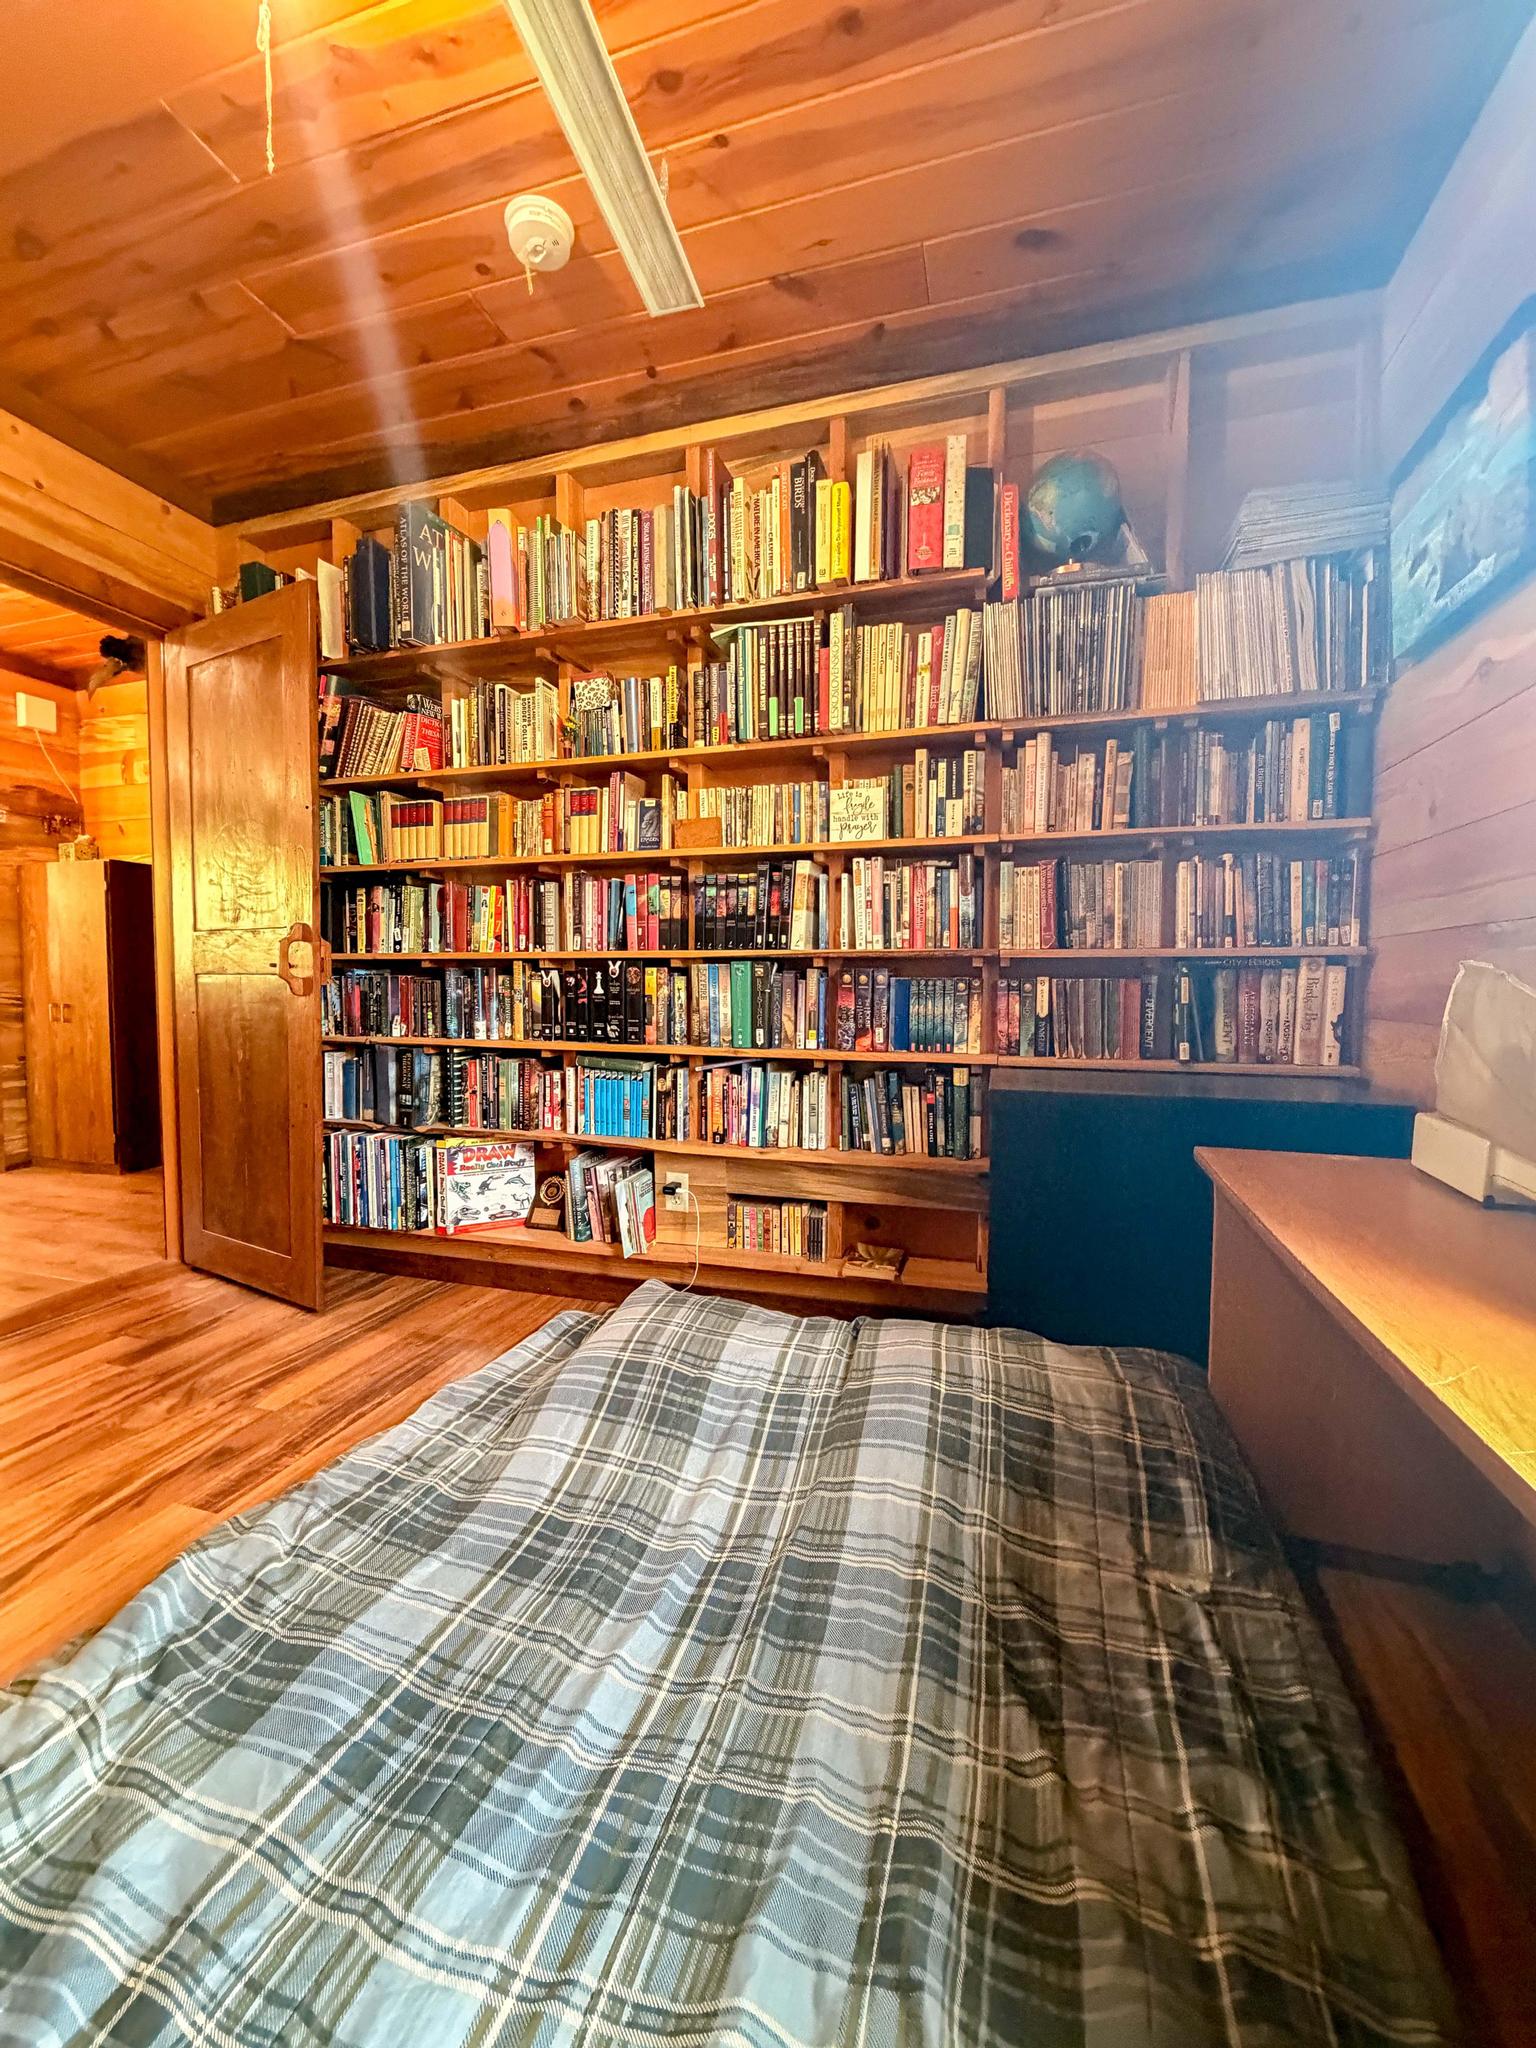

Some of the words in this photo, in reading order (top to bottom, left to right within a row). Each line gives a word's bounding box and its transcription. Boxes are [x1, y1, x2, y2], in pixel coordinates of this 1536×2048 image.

[794, 477, 803, 509] BIRDS
[707, 513, 716, 540] DOGS
[1003, 492, 1014, 544] Dictionary
[400, 517, 408, 548] ATLAS
[401, 550, 409, 562] OF
[401, 566, 409, 585] THE
[1004, 551, 1014, 591] Children
[930, 686, 940, 710] Birds
[401, 722, 412, 765] THESAURUS
[1256, 767, 1265, 794] Bridger
[837, 791, 853, 800] Life
[832, 814, 859, 823] handle
[860, 813, 879, 821] with
[838, 821, 877, 841] prayer
[700, 968, 708, 1001] SKYFIRE
[1304, 977, 1321, 1003] Birds
[856, 1005, 864, 1029] HADES
[863, 1006, 871, 1029] HOUSE
[1145, 998, 1154, 1049] DIVERGENT
[1222, 988, 1232, 1044] INSURGENT
[1244, 991, 1255, 1047] ALLEGIANT
[1301, 1012, 1319, 1033] Prey
[459, 1163, 485, 1172] Really
[486, 1161, 503, 1169] Cool
[503, 1158, 527, 1168] Stuff
[463, 1143, 517, 1164] DRAW
